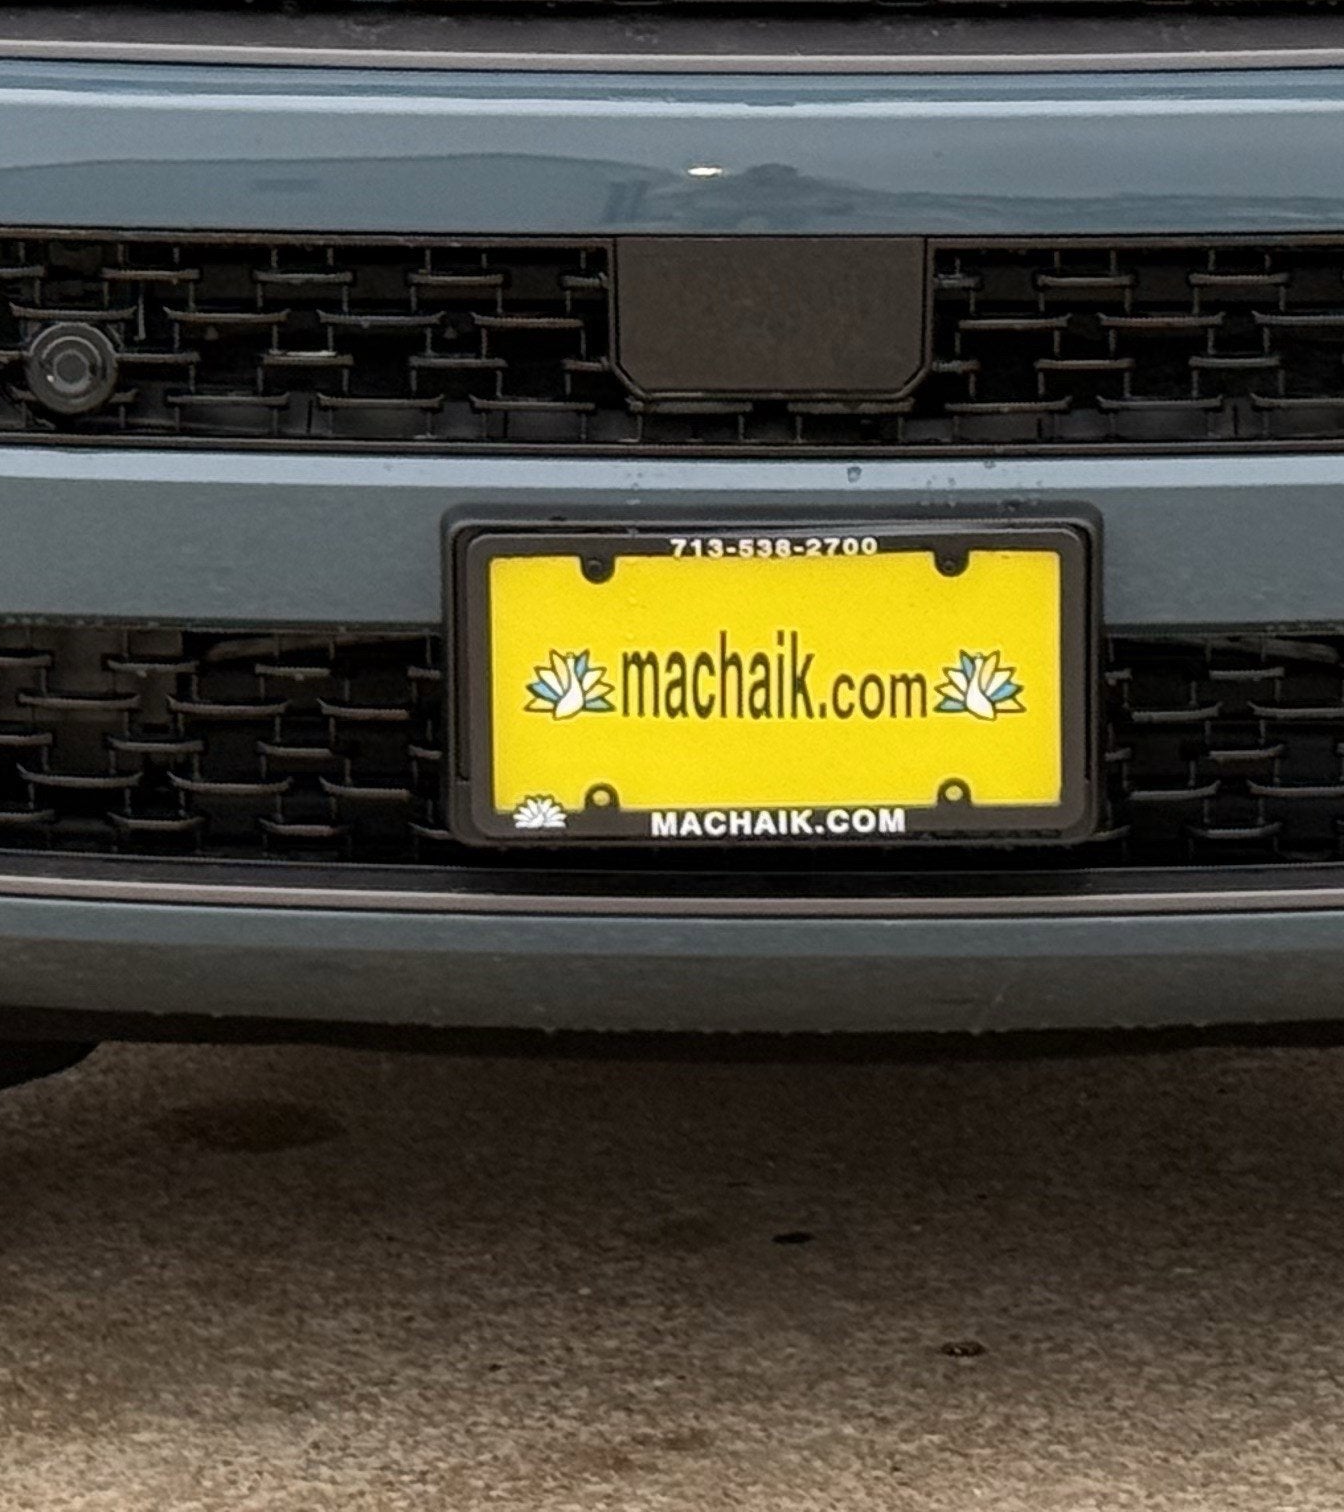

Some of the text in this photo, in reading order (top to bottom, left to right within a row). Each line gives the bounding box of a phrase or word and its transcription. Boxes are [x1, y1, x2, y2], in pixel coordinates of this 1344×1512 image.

[670, 537, 878, 558] 713-538-2700
[621, 630, 928, 719] machaik.com
[651, 808, 906, 836] MACHAIK.COM
